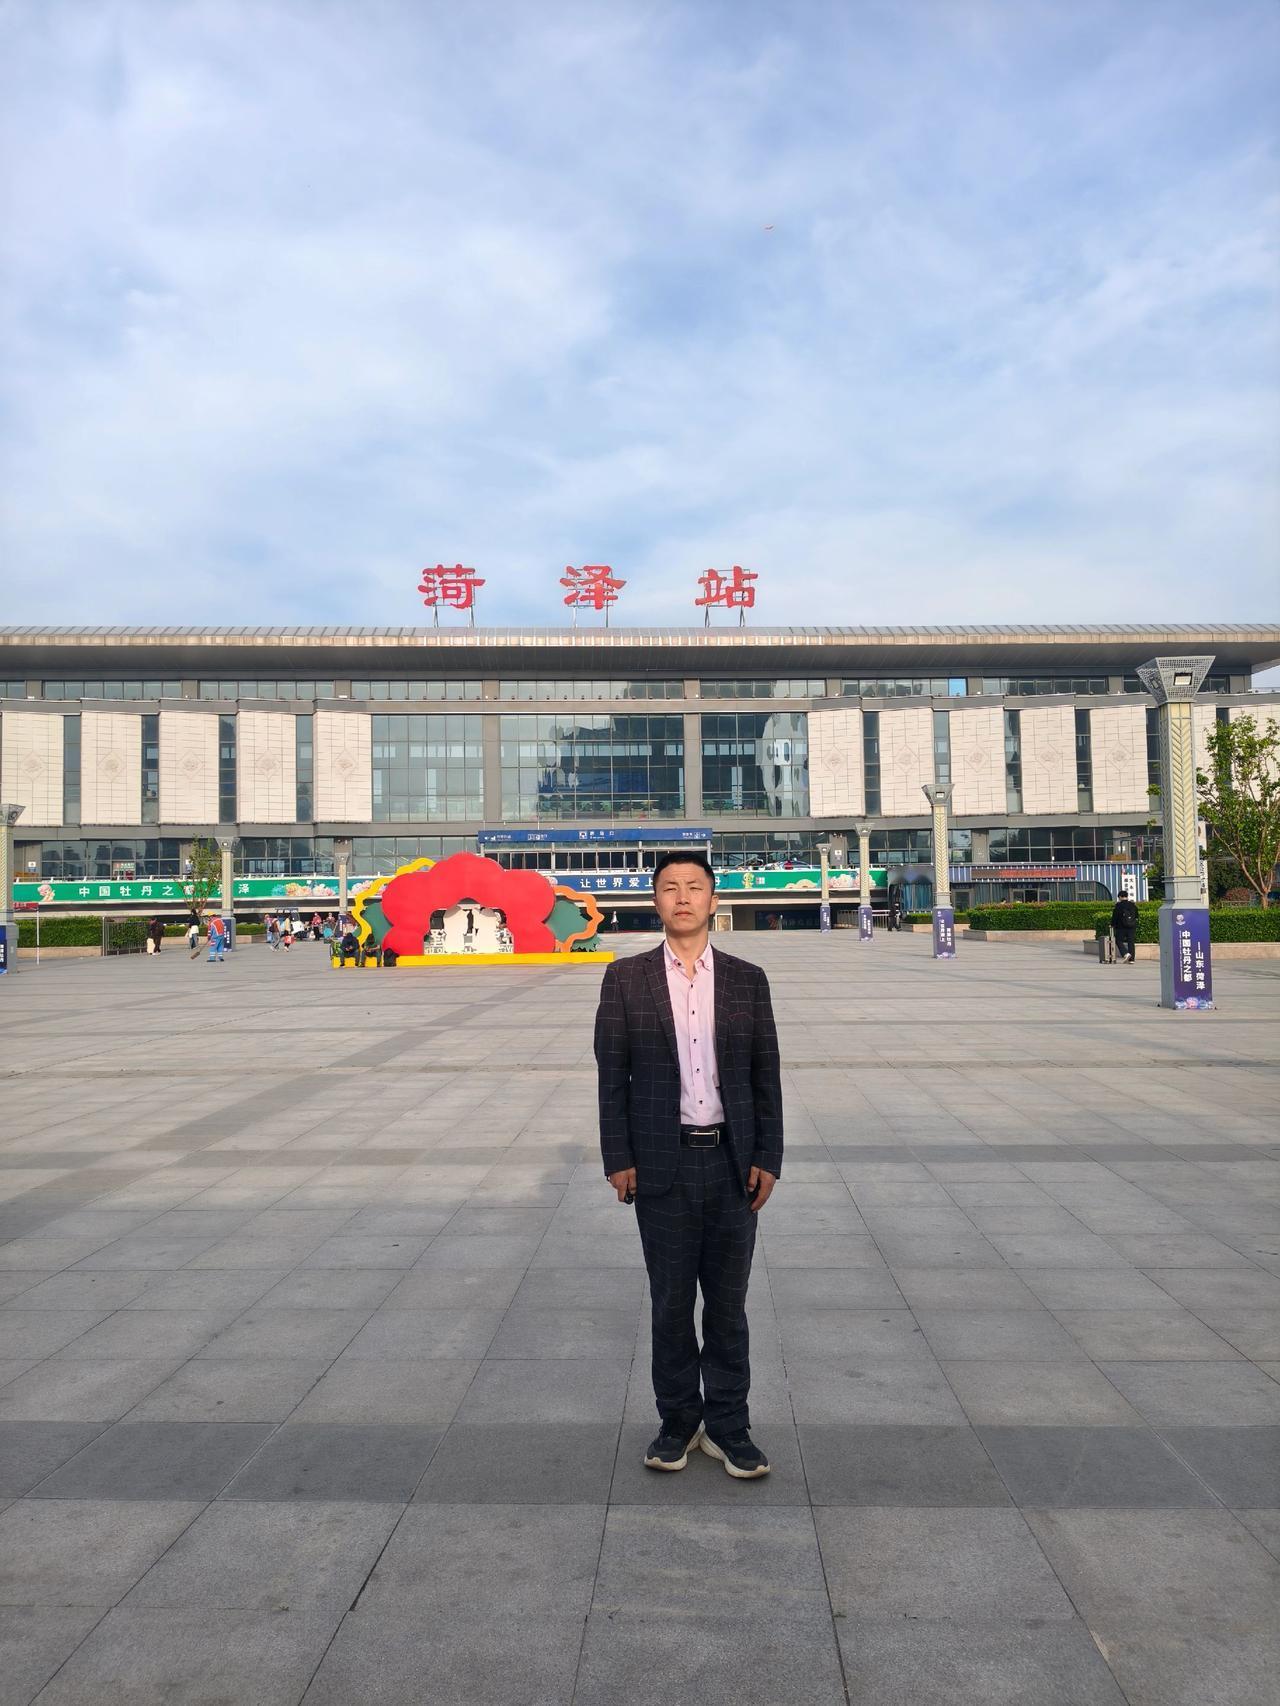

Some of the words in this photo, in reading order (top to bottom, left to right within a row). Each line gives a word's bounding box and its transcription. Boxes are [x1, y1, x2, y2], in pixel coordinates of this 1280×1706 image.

[418, 564, 758, 610] 菏泽站
[1182, 930, 1192, 982] 中国牡丹之都
